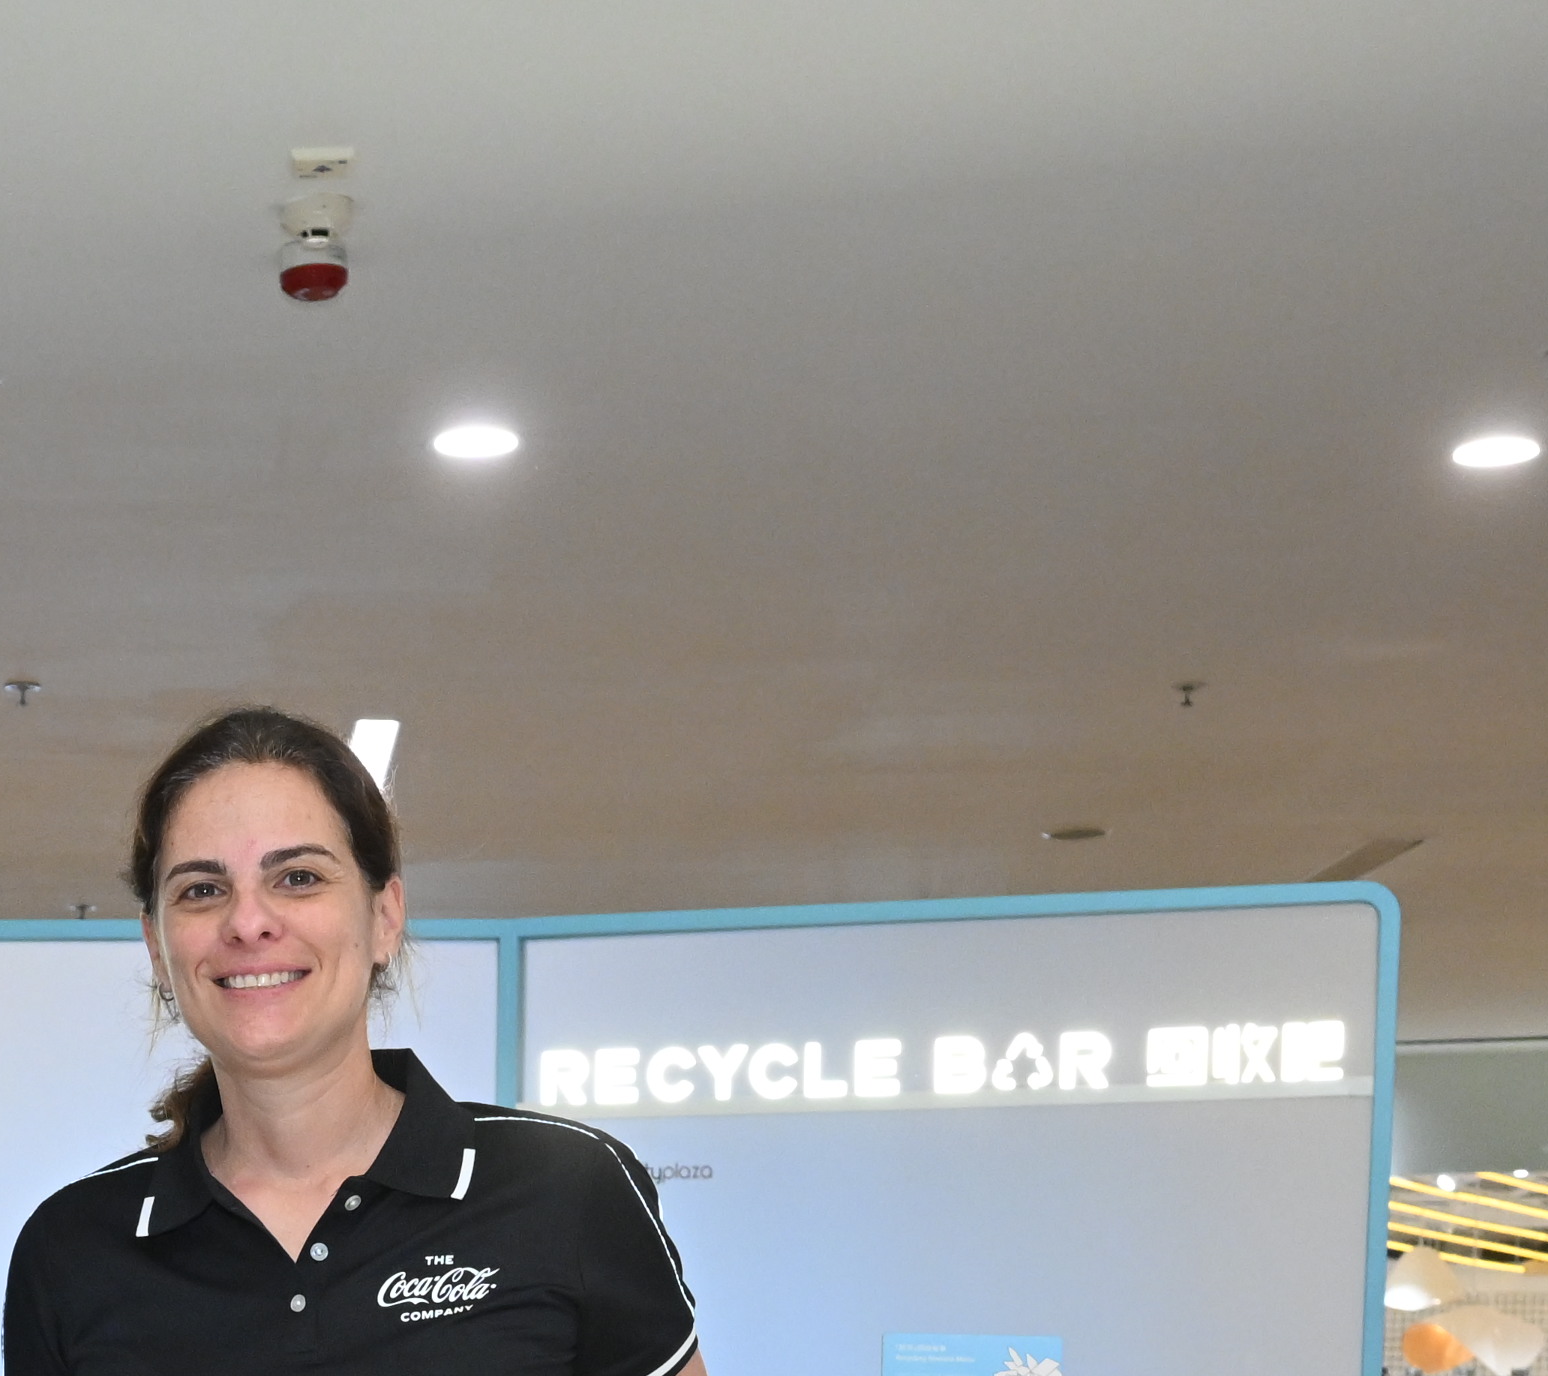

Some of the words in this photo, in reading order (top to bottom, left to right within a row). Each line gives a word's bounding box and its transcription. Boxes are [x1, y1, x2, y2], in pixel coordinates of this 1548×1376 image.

[539, 1037, 903, 1106] RECYCLE
[1145, 1018, 1346, 1088] 回收吧
[425, 1255, 454, 1266] THE
[400, 1304, 473, 1322] COMPANY
